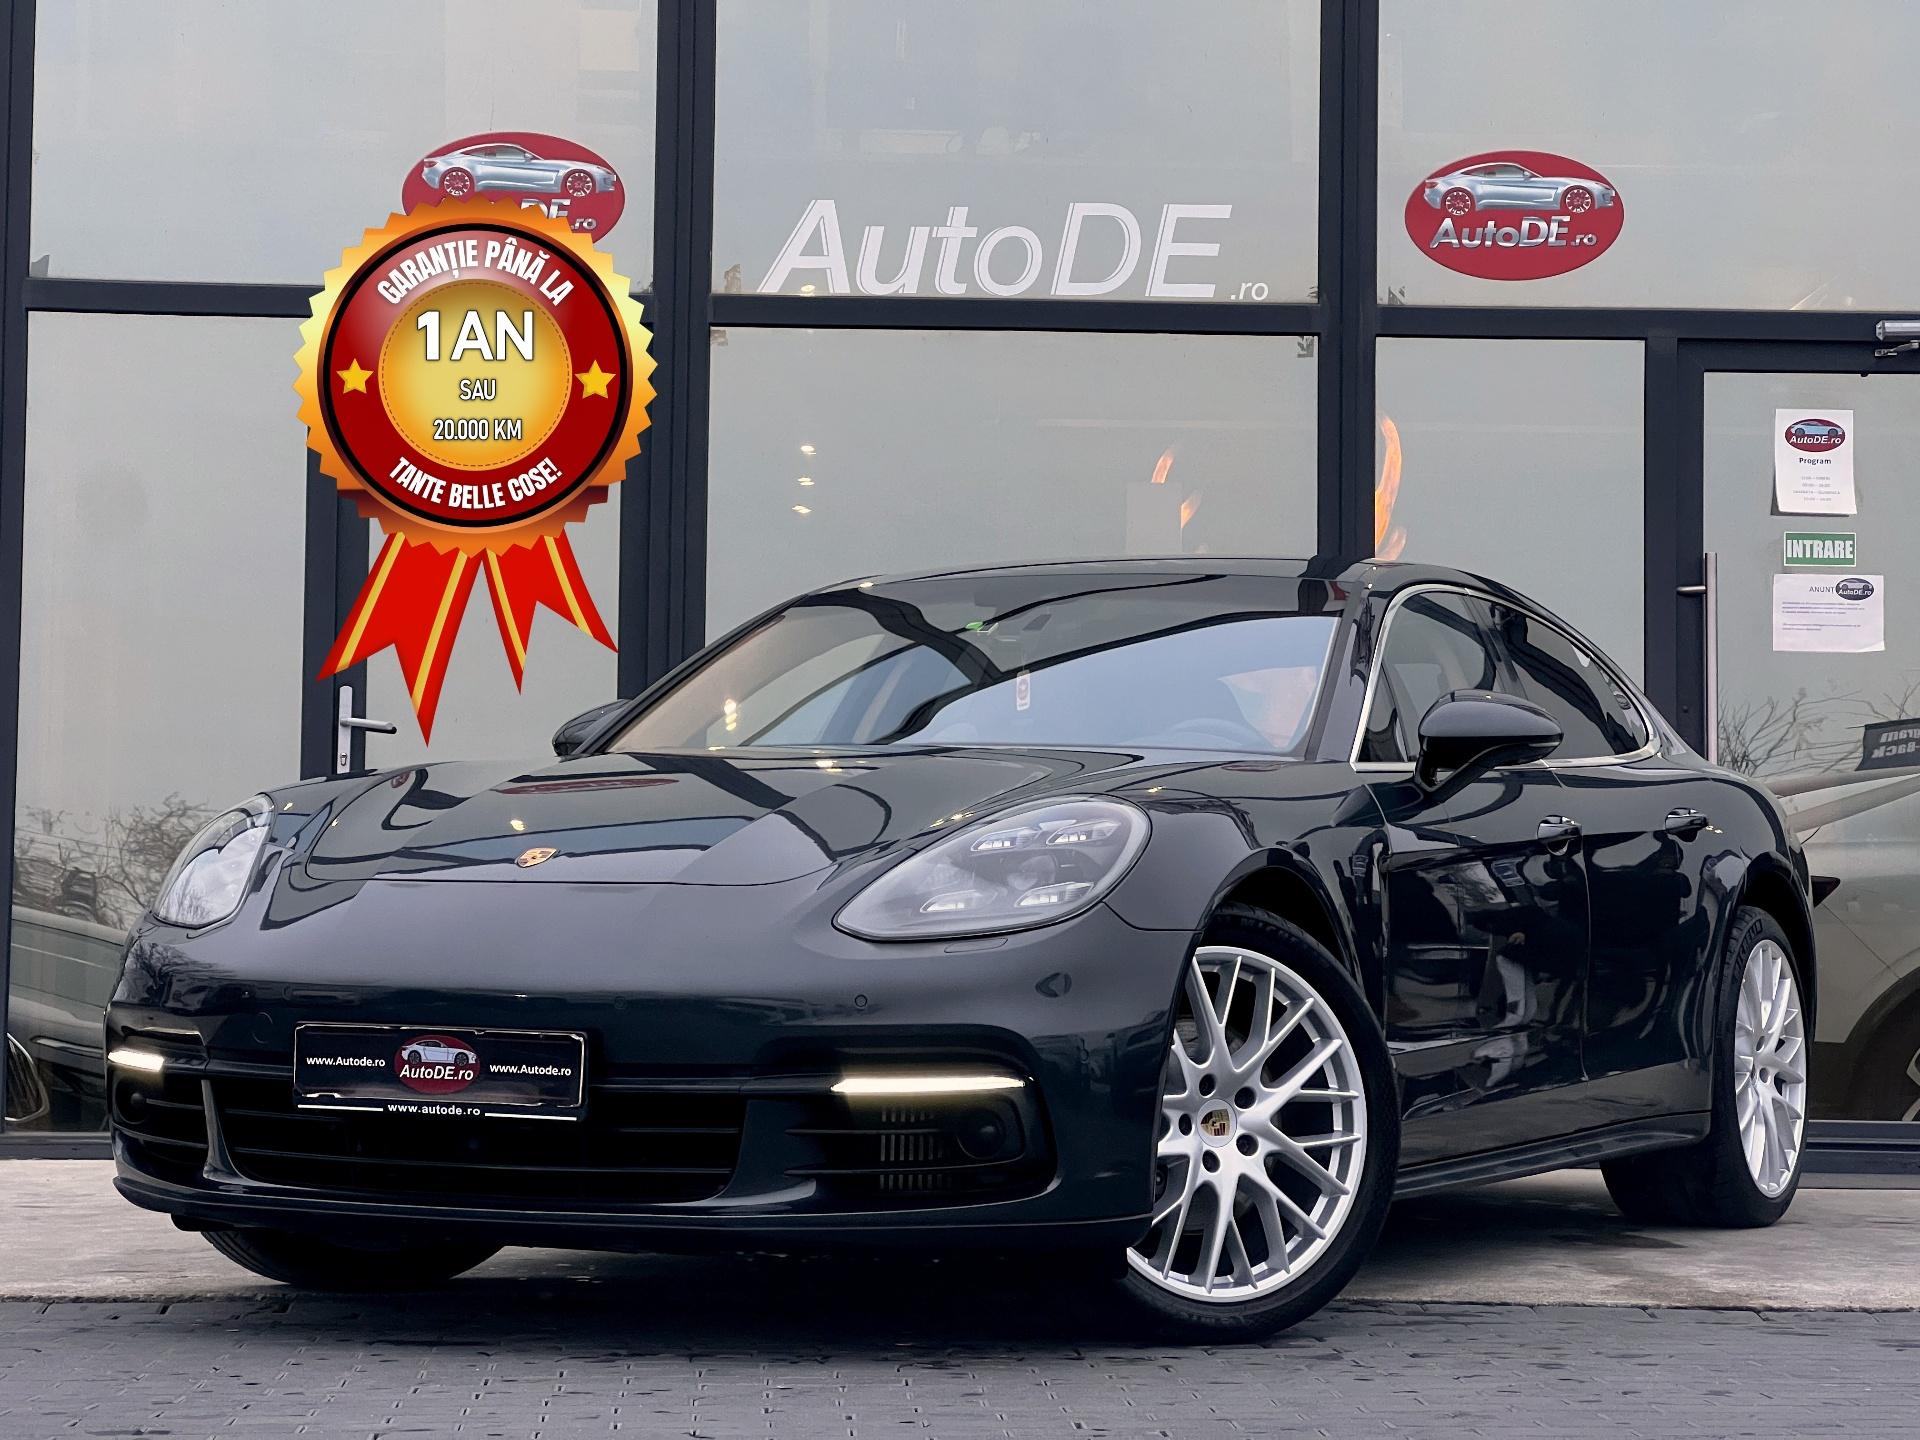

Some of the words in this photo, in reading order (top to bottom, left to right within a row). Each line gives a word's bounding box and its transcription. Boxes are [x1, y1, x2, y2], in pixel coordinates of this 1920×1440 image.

[1790, 435, 1841, 444] AutoDE.ro
[1799, 457, 1832, 466] Program
[1786, 539, 1854, 559] INTRARE
[1838, 587, 1872, 596] AutoDE.ro
[306, 1056, 386, 1068] www.Autode.ro
[399, 1064, 474, 1081] AutoDE.ro
[489, 1063, 572, 1077] www.Autode.ro
[387, 1103, 481, 1116] www.autode.ro
